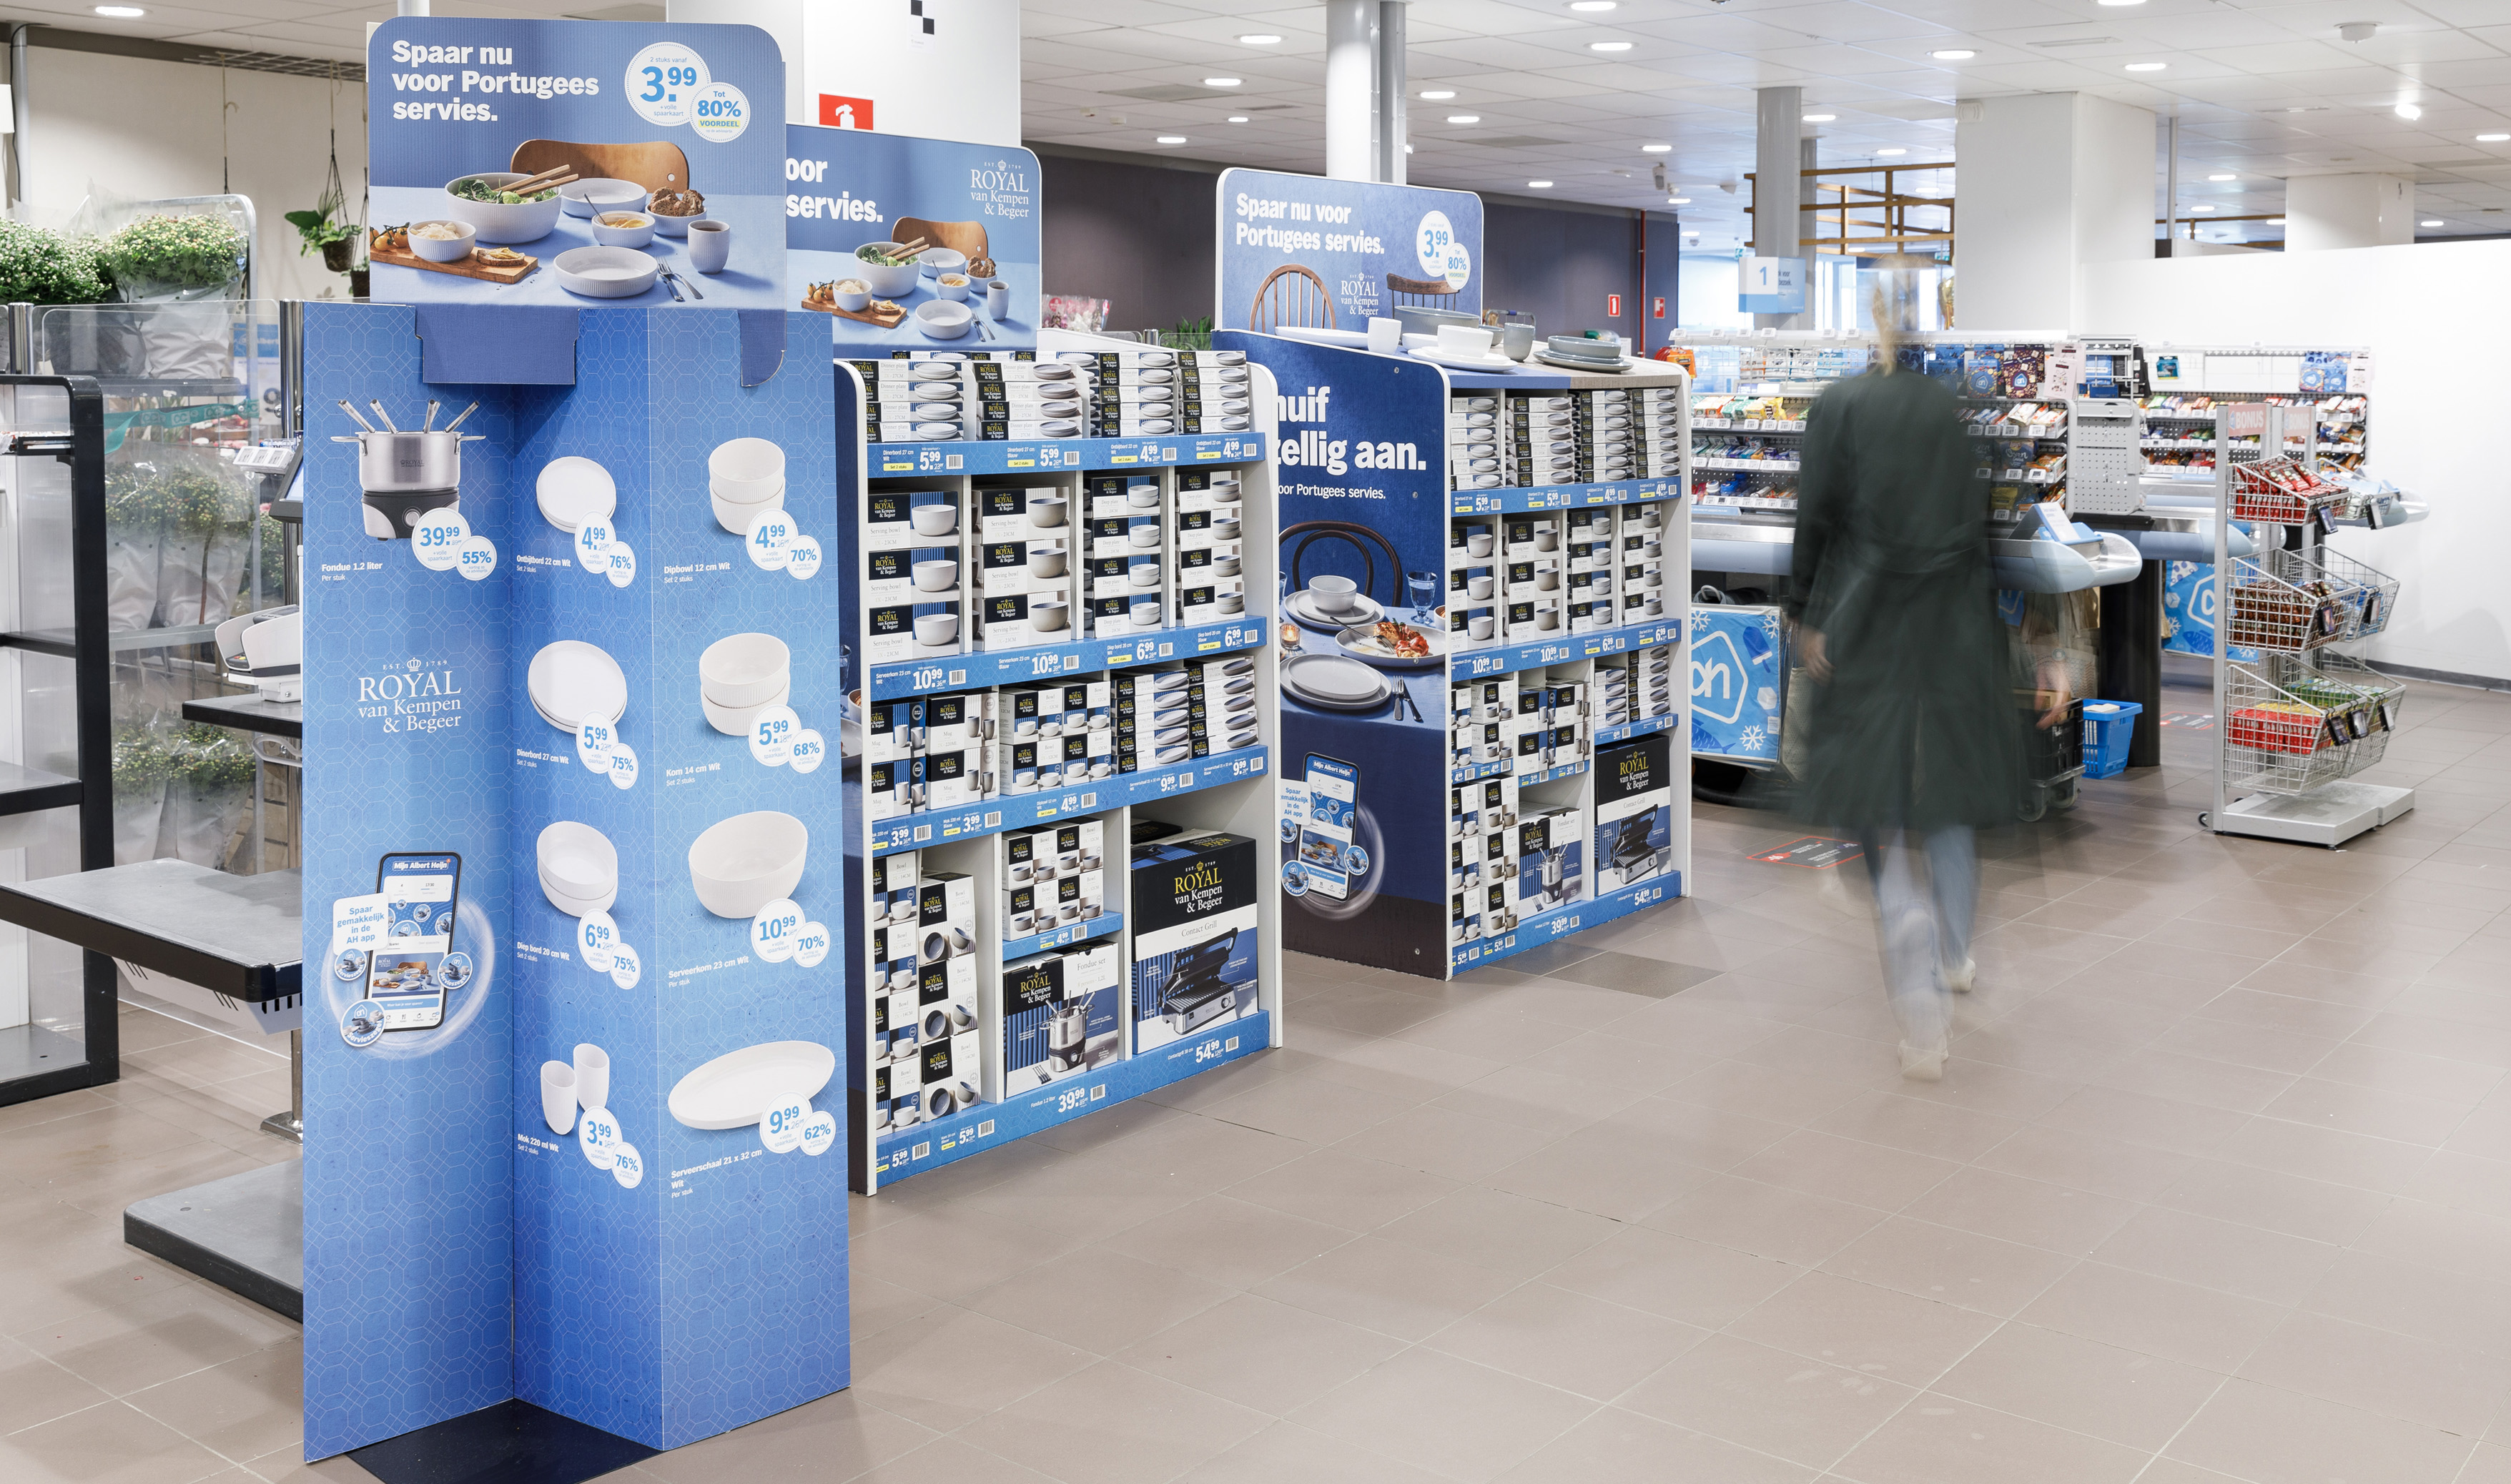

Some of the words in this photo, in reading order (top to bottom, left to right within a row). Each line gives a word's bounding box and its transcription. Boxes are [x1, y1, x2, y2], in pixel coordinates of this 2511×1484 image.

[392, 40, 473, 68] Spaar
[480, 45, 513, 65] nu
[392, 72, 454, 92] voor
[462, 71, 599, 99] Portugees
[640, 66, 697, 102] 3.99
[393, 97, 498, 122] servies.
[697, 100, 741, 117] 80%
[786, 157, 827, 183] oor
[970, 169, 1030, 193] ROYAL
[786, 191, 883, 222] servies.
[970, 191, 989, 201] van
[990, 190, 1030, 207] Kempen
[985, 203, 995, 215] &
[997, 204, 1030, 219] Begeer
[1235, 192, 1288, 222] Spaar
[1291, 202, 1311, 221] nu
[1315, 204, 1351, 224] voor
[1235, 222, 1321, 254] Portugees
[1325, 230, 1385, 254] servies.
[1424, 229, 1449, 257] 3.99
[1448, 257, 1466, 270] 80%
[1760, 266, 1767, 285] 1
[1341, 280, 1378, 297] ROYAL
[1341, 297, 1351, 305] van
[1353, 295, 1378, 308] Kempen
[1349, 305, 1356, 315] &
[1358, 305, 1378, 317] Begeer
[2235, 411, 2264, 428] BONUS
[2290, 412, 2310, 429] BONUS
[919, 451, 941, 470] 5.99
[1140, 445, 1158, 462] 4.99
[1354, 440, 1426, 470] aan.
[1278, 485, 1294, 495] oor
[1296, 483, 1345, 499] Portugees
[1348, 487, 1386, 499] servies.
[419, 526, 460, 547] 39.99
[581, 526, 606, 550] 4.99
[754, 524, 786, 548] 4.99
[462, 550, 492, 564] 55%
[516, 555, 544, 565] Ontbijtbord
[544, 557, 551, 565] 22
[561, 558, 571, 567] Wit
[609, 555, 631, 570] 76%
[790, 548, 817, 563] 70%
[322, 563, 351, 573] Fondue
[353, 562, 365, 571] 1.2
[367, 562, 383, 571] liter
[663, 563, 694, 575] Dipbowl
[718, 562, 731, 570] Wit
[1136, 641, 1155, 661] 6.99
[1032, 653, 1059, 675] 10.99
[357, 671, 462, 703] ROYAL
[912, 668, 942, 691] 10.99
[357, 704, 388, 718] van
[394, 698, 461, 717] Kempen
[383, 716, 401, 733] &
[406, 715, 461, 733] Begeer
[759, 719, 789, 746] 5.99
[583, 725, 608, 751] 5.99
[516, 748, 542, 760] Dinerbord
[559, 755, 569, 765] Wit
[793, 741, 820, 757] 68%
[611, 756, 634, 772] 75%
[666, 768, 683, 777] Kom
[684, 766, 694, 775] 14
[709, 763, 721, 771] Wit
[1619, 756, 1649, 776] ROYAL
[1629, 771, 1649, 781] Kempen
[1632, 778, 1649, 789] Begeer
[393, 861, 408, 871] Mijn
[409, 861, 430, 870] Albert
[430, 861, 448, 869] Heijn
[1174, 867, 1223, 894] ROYAL
[1175, 894, 1190, 906] van
[1191, 885, 1223, 904] Kempen
[349, 906, 373, 916] Spaar
[1186, 903, 1196, 914] &
[1197, 896, 1223, 911] Begeer
[337, 912, 385, 928] gemakkelijk
[360, 924, 370, 932] de
[759, 915, 796, 941] 10.99
[1181, 924, 1203, 938] Contact
[1204, 920, 1217, 931] Grill
[346, 936, 359, 944] AH
[360, 934, 375, 944] app
[585, 924, 609, 949] 6.99
[798, 934, 824, 951] 70%
[517, 941, 528, 952] Diep
[530, 943, 542, 953] bord
[560, 950, 570, 961] Wit
[613, 956, 636, 972] 75%
[669, 962, 712, 979] Serveerkom
[714, 961, 723, 970] 23
[724, 959, 736, 967] cm
[736, 955, 749, 964] Wit
[1077, 959, 1096, 971] Fondue
[1020, 975, 1051, 993] ROYAL
[1030, 985, 1051, 998] Kempen
[1034, 991, 1051, 1002] Begeer
[1195, 1039, 1220, 1064] 54.99
[1058, 1087, 1085, 1113] 39.99
[769, 1106, 799, 1134] 9.99
[586, 1120, 611, 1146] 3.99
[804, 1122, 831, 1141] 62%
[518, 1134, 530, 1143] Mok
[531, 1137, 541, 1147] 220
[541, 1141, 548, 1149] ml
[549, 1143, 559, 1153] Wit
[616, 1154, 638, 1172] 76%
[671, 1158, 722, 1179] Serveerschaal
[724, 1155, 733, 1165] 21
[740, 1152, 750, 1161] 32
[751, 1149, 763, 1158] cm
[671, 1179, 684, 1189] Wit
[671, 1190, 681, 1199] Per
[681, 1187, 694, 1196] stuk
